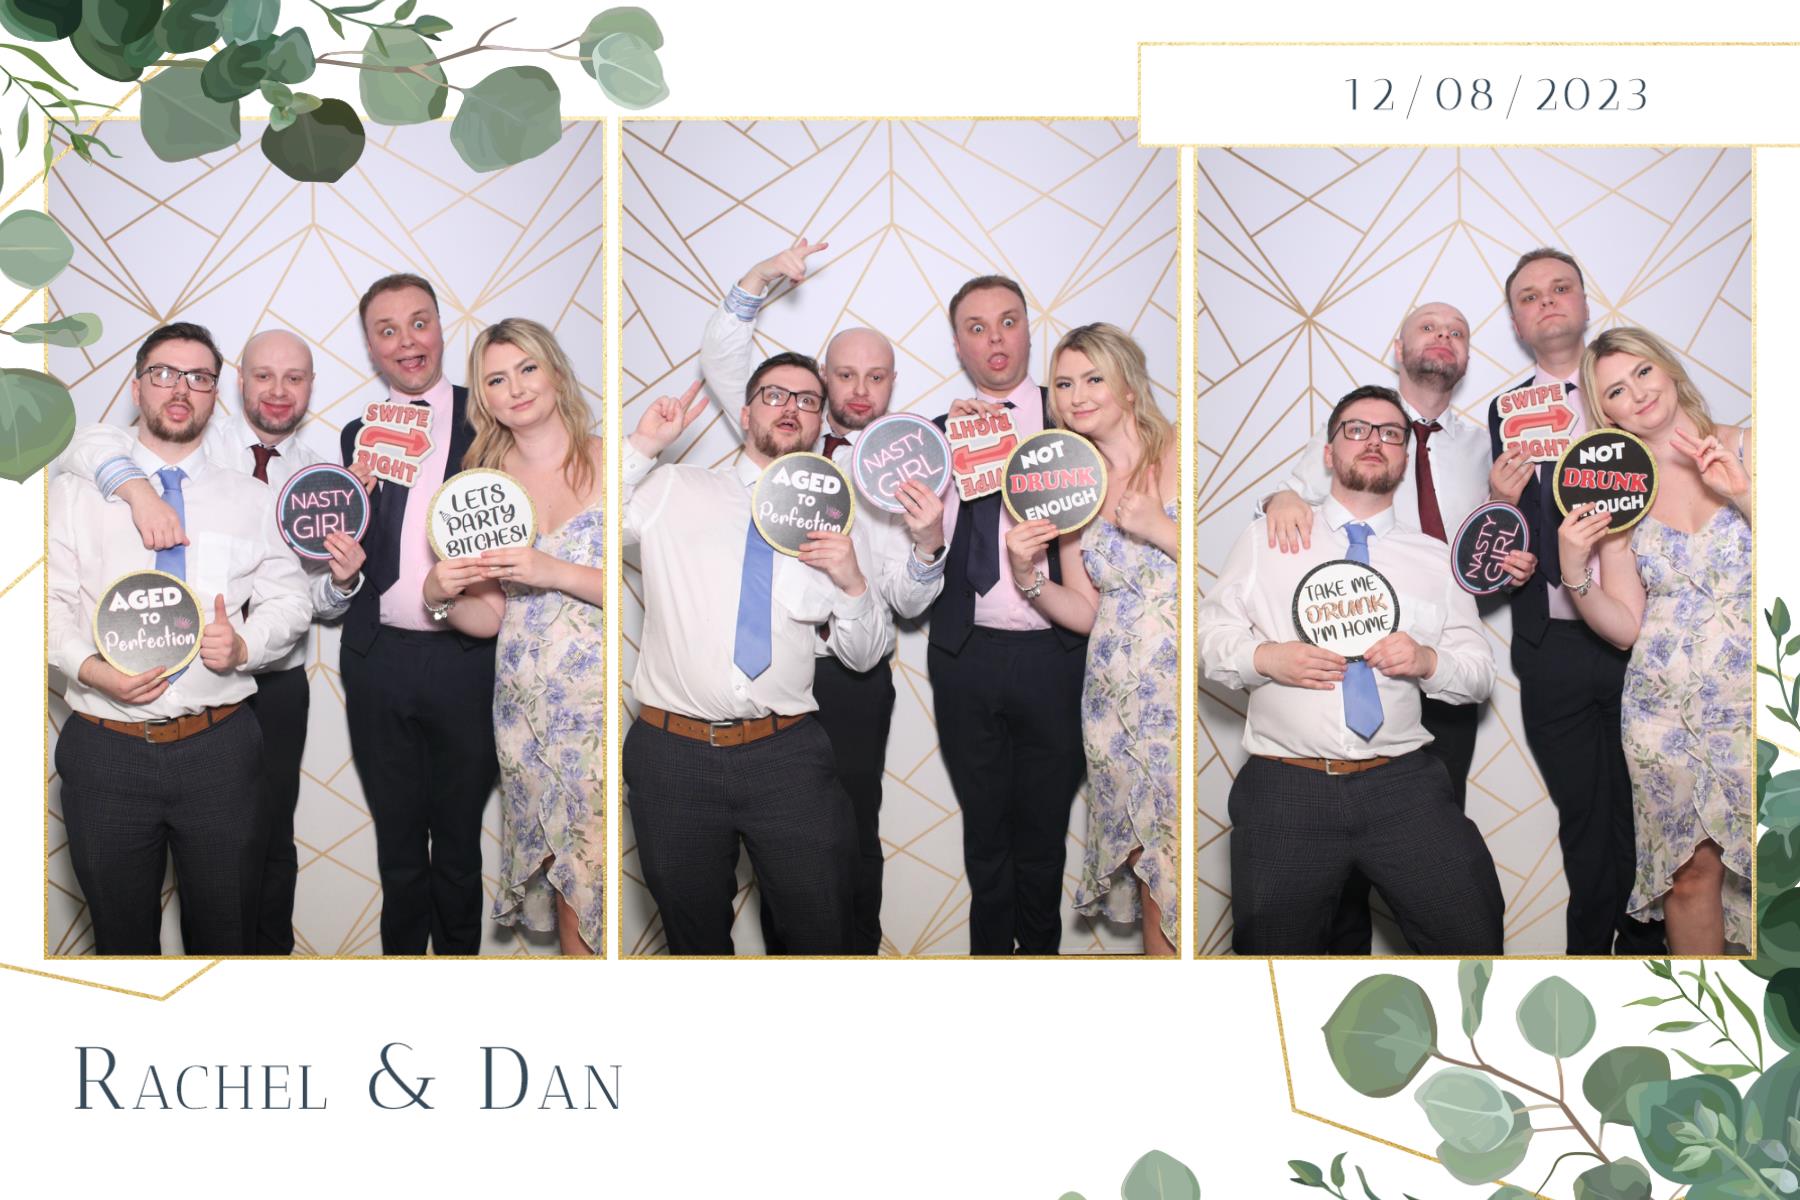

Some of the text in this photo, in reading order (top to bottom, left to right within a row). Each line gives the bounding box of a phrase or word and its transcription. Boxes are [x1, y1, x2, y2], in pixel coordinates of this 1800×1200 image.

[1500, 384, 1563, 414] SWIPE
[366, 403, 430, 428] SWIPE
[949, 412, 1013, 440] RIGHT
[863, 428, 924, 474] NASTY
[1020, 440, 1064, 469] NOT
[1579, 442, 1625, 465] NOT
[357, 450, 417, 483] RIGHT
[772, 466, 841, 494] AGED
[878, 454, 944, 497] GIRL
[1009, 466, 1097, 494] DRUNK
[1562, 467, 1648, 493] DRUNK
[960, 467, 1003, 498] IPE
[291, 488, 355, 511] NASTY
[451, 483, 506, 513] LETS
[797, 493, 816, 507] TO
[1025, 487, 1098, 521] ENOUGH
[293, 512, 357, 539] GIRL
[446, 503, 516, 536] PARTY
[759, 501, 841, 533] Perfection
[446, 523, 528, 558] BITCHES!
[1465, 514, 1497, 579] NASTY
[1484, 523, 1520, 582] GIRL
[108, 586, 182, 612] AGED
[1305, 574, 1377, 601] TAKE ME
[139, 612, 160, 625] TO
[1305, 593, 1388, 624] DRUNK
[104, 625, 196, 653] Perfection
[1312, 614, 1391, 644] I'M HOME
